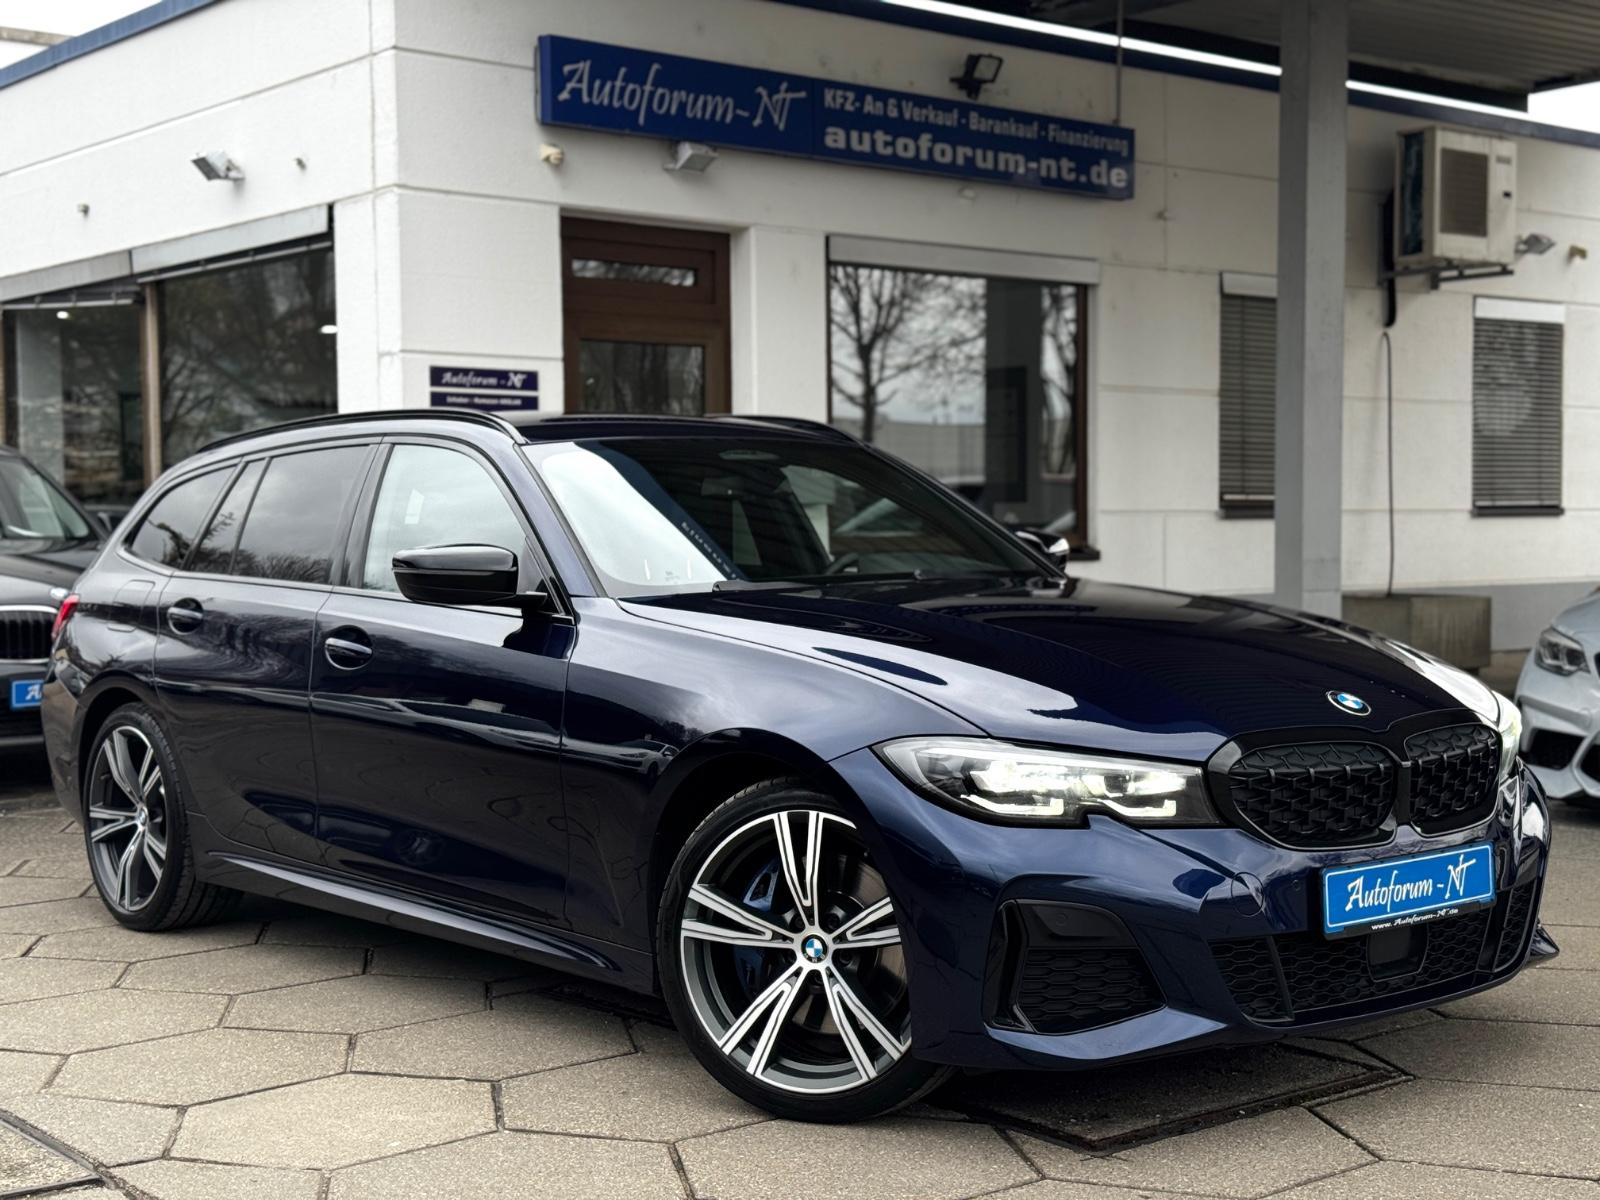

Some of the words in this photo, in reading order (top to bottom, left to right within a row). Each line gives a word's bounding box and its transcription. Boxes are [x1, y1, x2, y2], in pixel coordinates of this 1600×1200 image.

[557, 59, 807, 131] Autoforum-NT
[863, 94, 884, 115] An
[887, 98, 899, 119] &
[901, 100, 960, 127] Verkauf
[969, 110, 1039, 140] Barankauf
[1047, 123, 1129, 157] Finanzierung
[824, 125, 1128, 188] autoforum-nt.de
